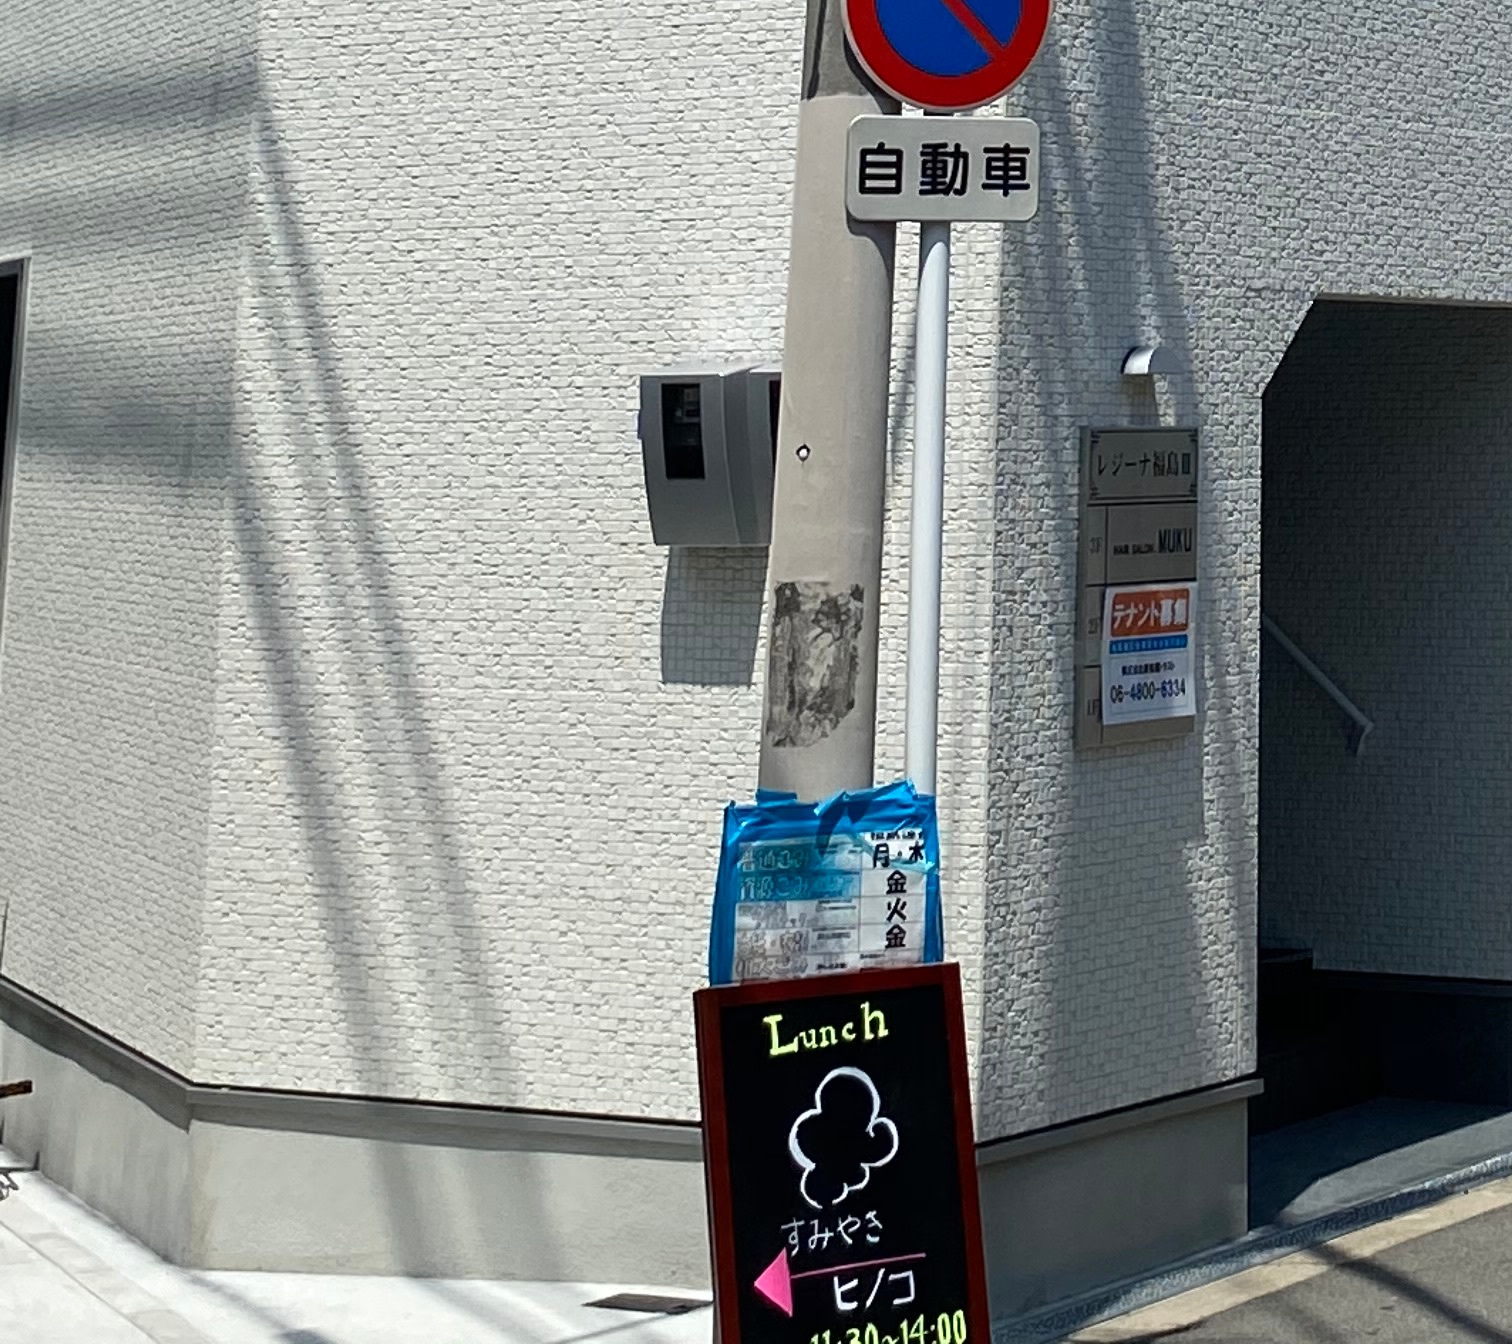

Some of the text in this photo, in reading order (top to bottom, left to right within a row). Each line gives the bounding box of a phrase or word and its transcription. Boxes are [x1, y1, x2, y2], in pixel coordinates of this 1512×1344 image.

[858, 141, 1031, 197] 自動車
[1158, 527, 1193, 553] MUKU
[886, 869, 908, 895] 金
[886, 897, 908, 923] 火
[884, 923, 907, 949] 金
[762, 1000, 889, 1056] Lunch
[781, 1210, 883, 1257] すみやき
